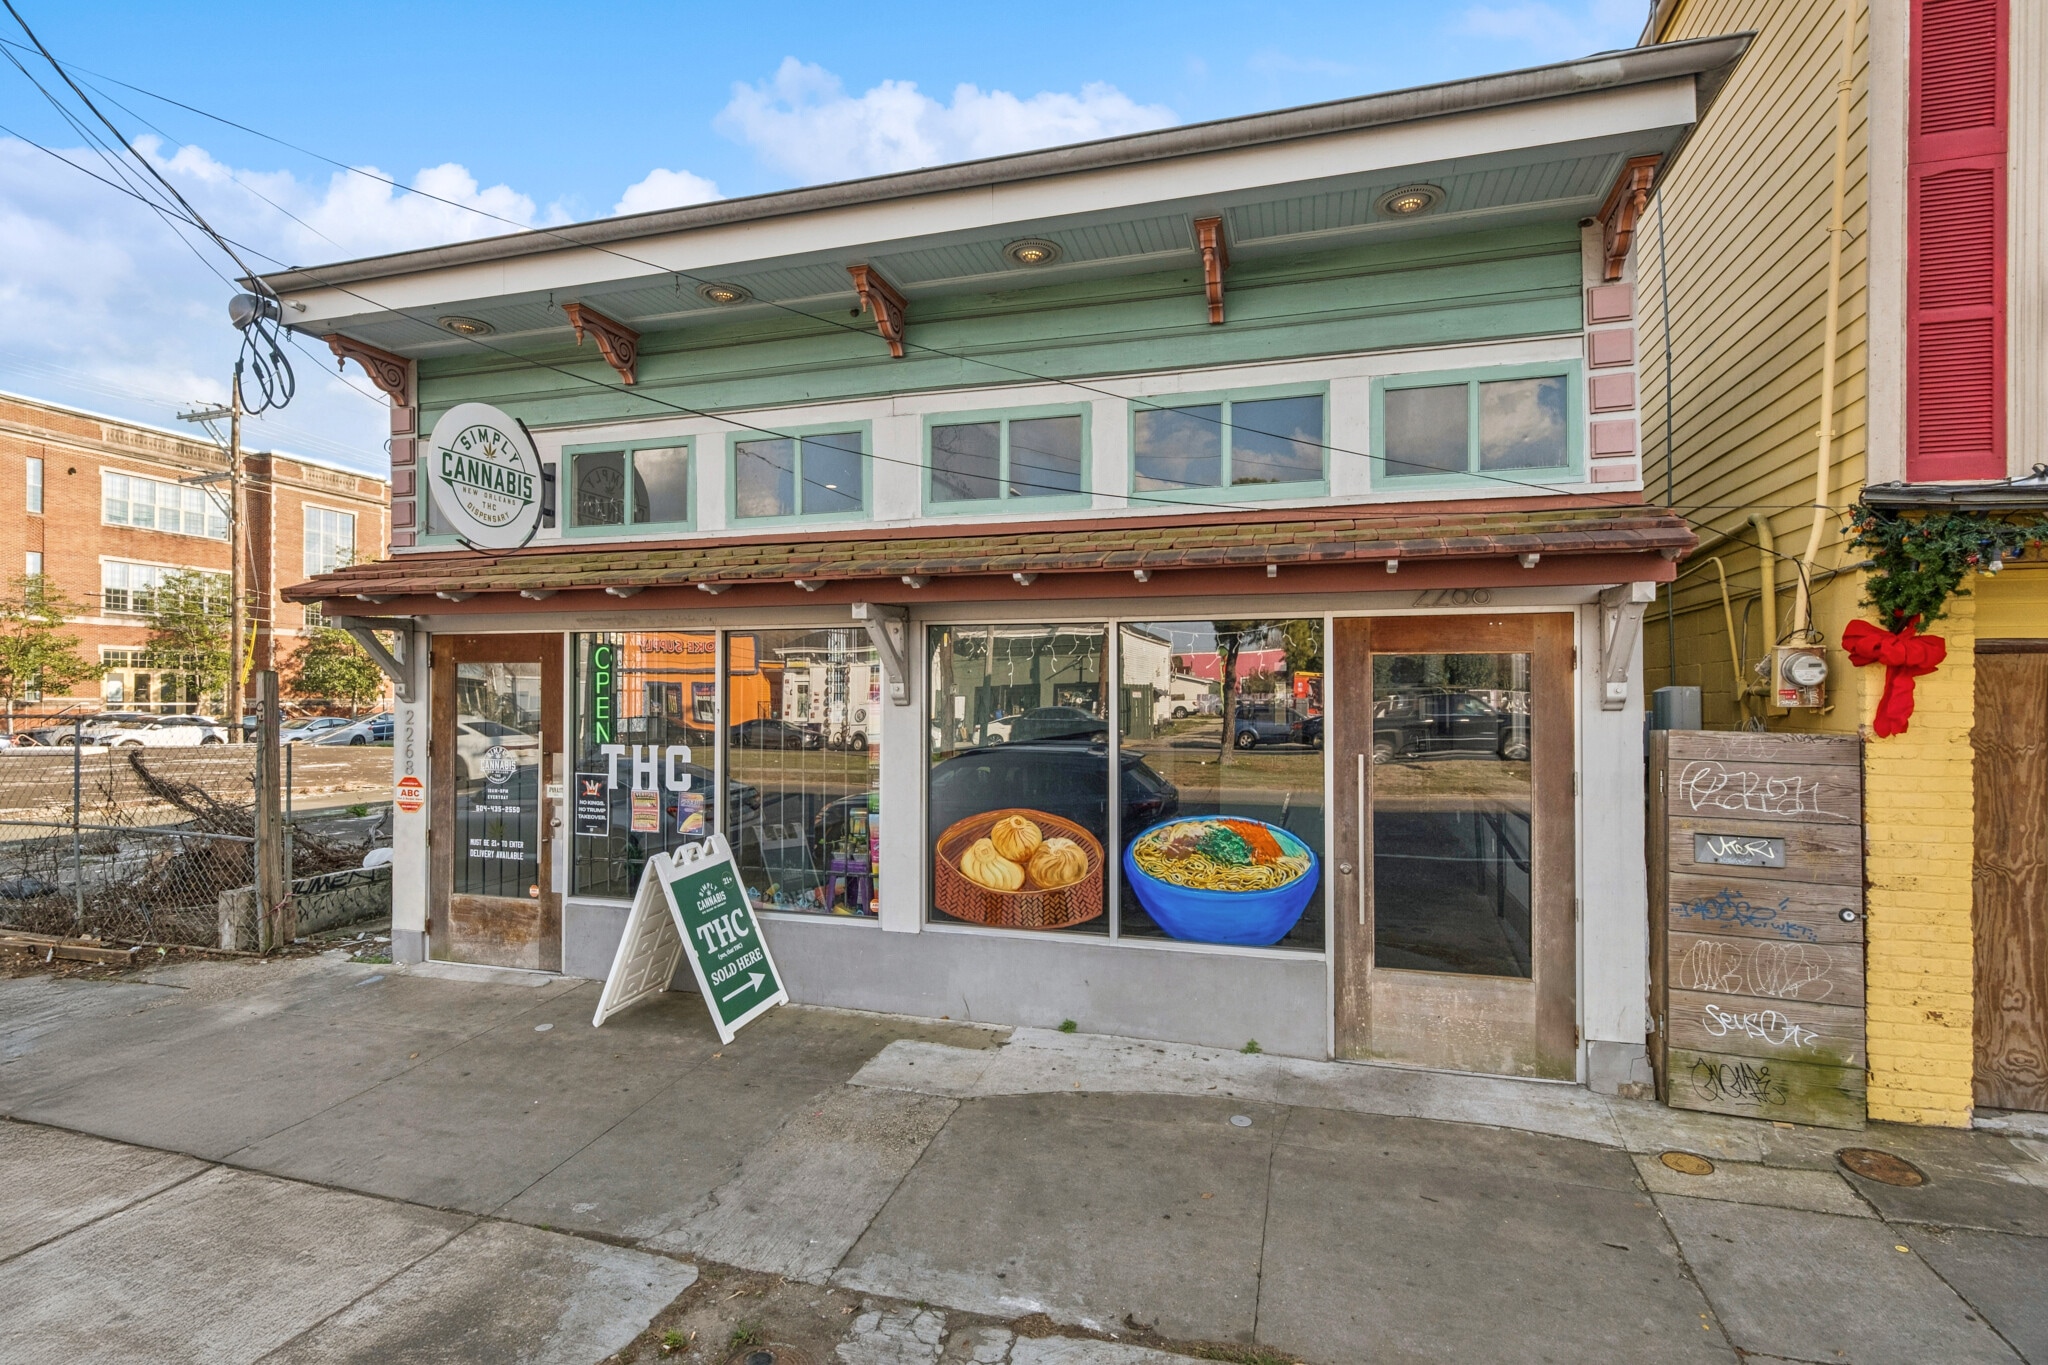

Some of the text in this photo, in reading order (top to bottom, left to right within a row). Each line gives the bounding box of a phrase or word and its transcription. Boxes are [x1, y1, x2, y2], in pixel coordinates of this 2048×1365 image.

[460, 428, 519, 463] SIMPLY
[442, 452, 533, 499] CANNABIS
[462, 486, 516, 506] NEW ORLEANS
[466, 502, 510, 523] DISPENSARY
[482, 501, 497, 512] THC
[595, 646, 611, 744] OPEN
[405, 710, 414, 775] 2268
[480, 760, 516, 770] CANNABIS
[601, 744, 692, 792] THC
[401, 789, 420, 797] ABC
[475, 805, 521, 814] 504-435-2550
[470, 838, 482, 846] MUST
[483, 839, 490, 847] BE
[501, 840, 508, 848] TO
[509, 840, 524, 849] ENTER
[470, 849, 524, 861] DELIVERY AVAILABLE
[698, 882, 718, 897] SIMPLY
[722, 876, 733, 885] 21+
[697, 890, 727, 911] CANNABIS
[696, 907, 749, 954] THC
[710, 947, 764, 986] SOLD HERE
